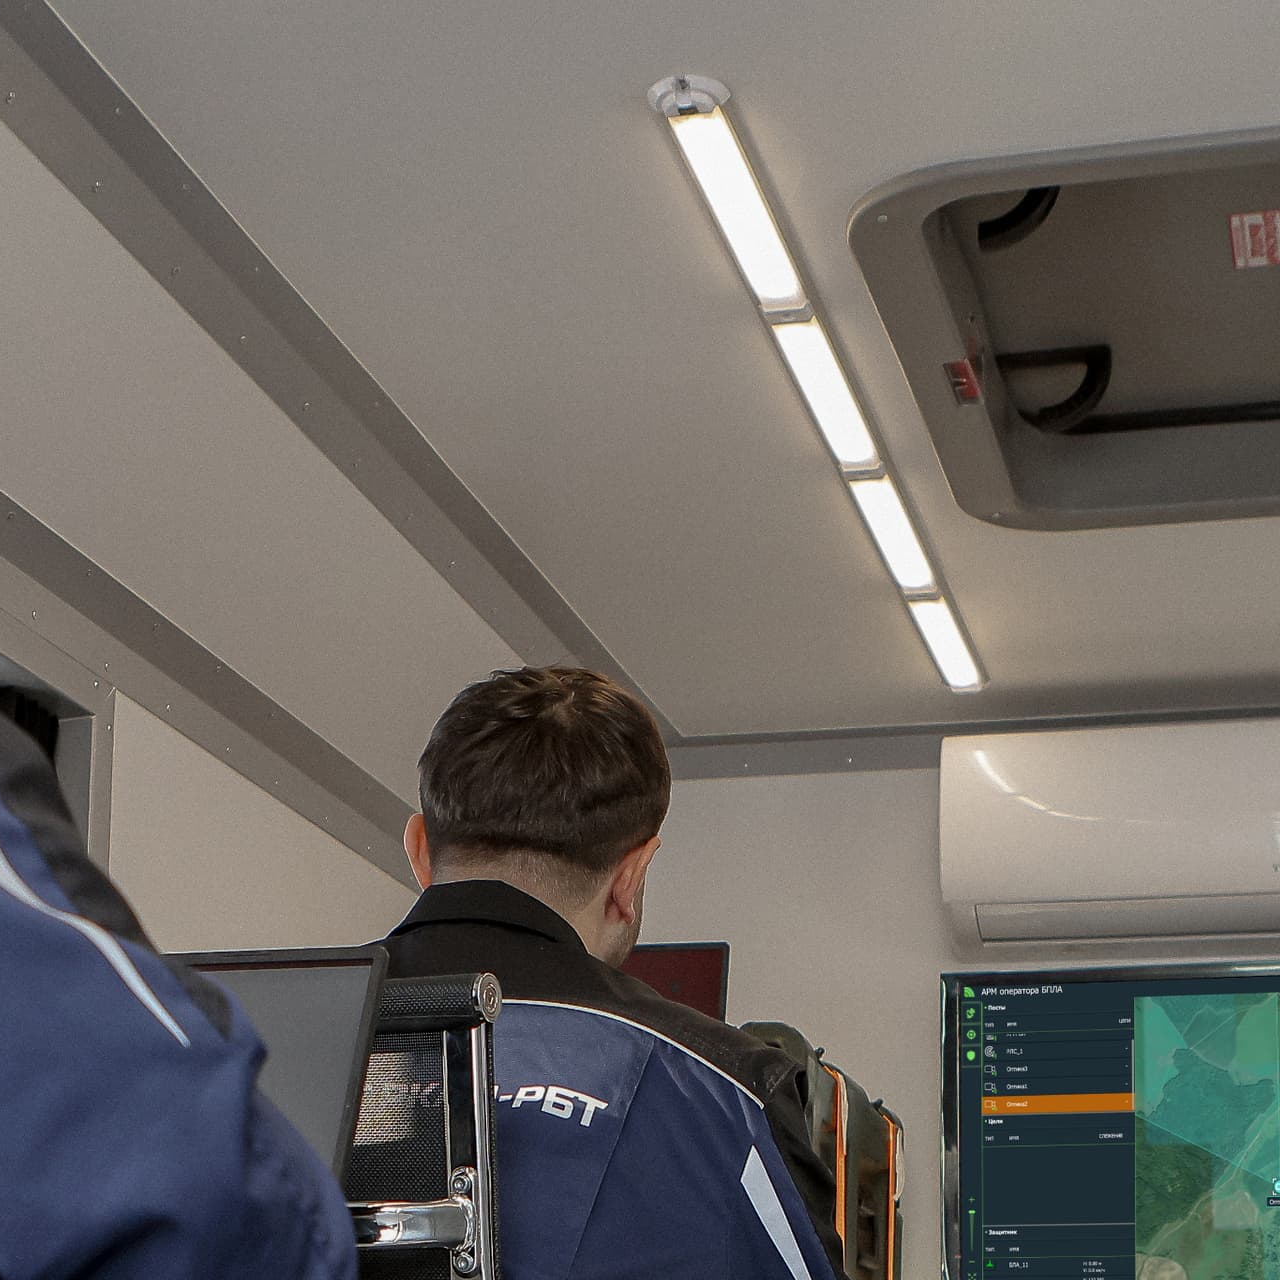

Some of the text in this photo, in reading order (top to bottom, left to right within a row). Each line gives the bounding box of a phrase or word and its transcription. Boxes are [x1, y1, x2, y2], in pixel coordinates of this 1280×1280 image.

[981, 985, 1063, 997] АРМ оператора БПЛА
